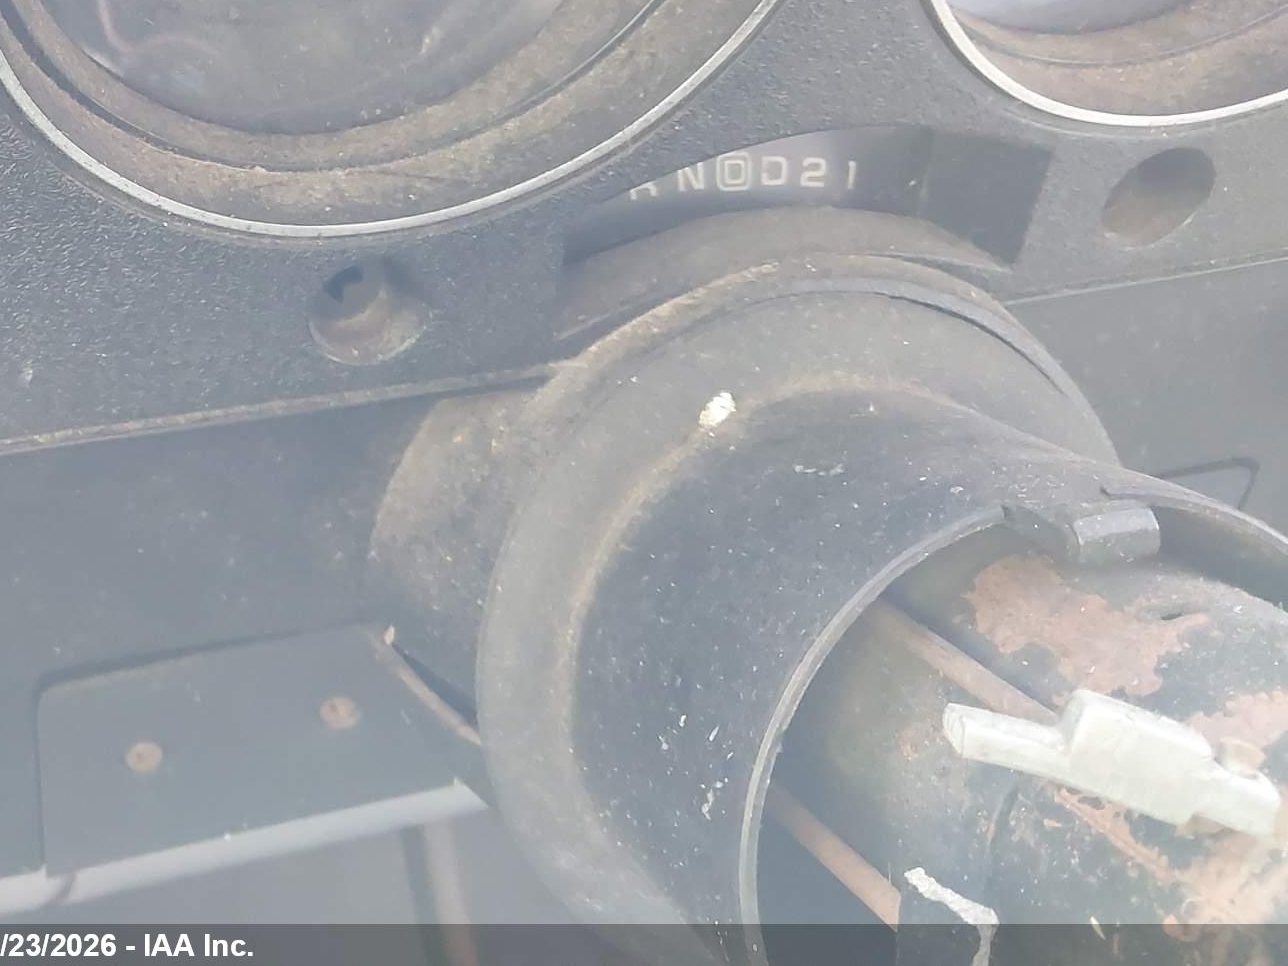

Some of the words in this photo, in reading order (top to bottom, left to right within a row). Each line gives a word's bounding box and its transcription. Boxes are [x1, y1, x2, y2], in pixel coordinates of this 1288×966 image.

[677, 162, 704, 192] N
[761, 155, 788, 186] D
[800, 157, 827, 187] 2
